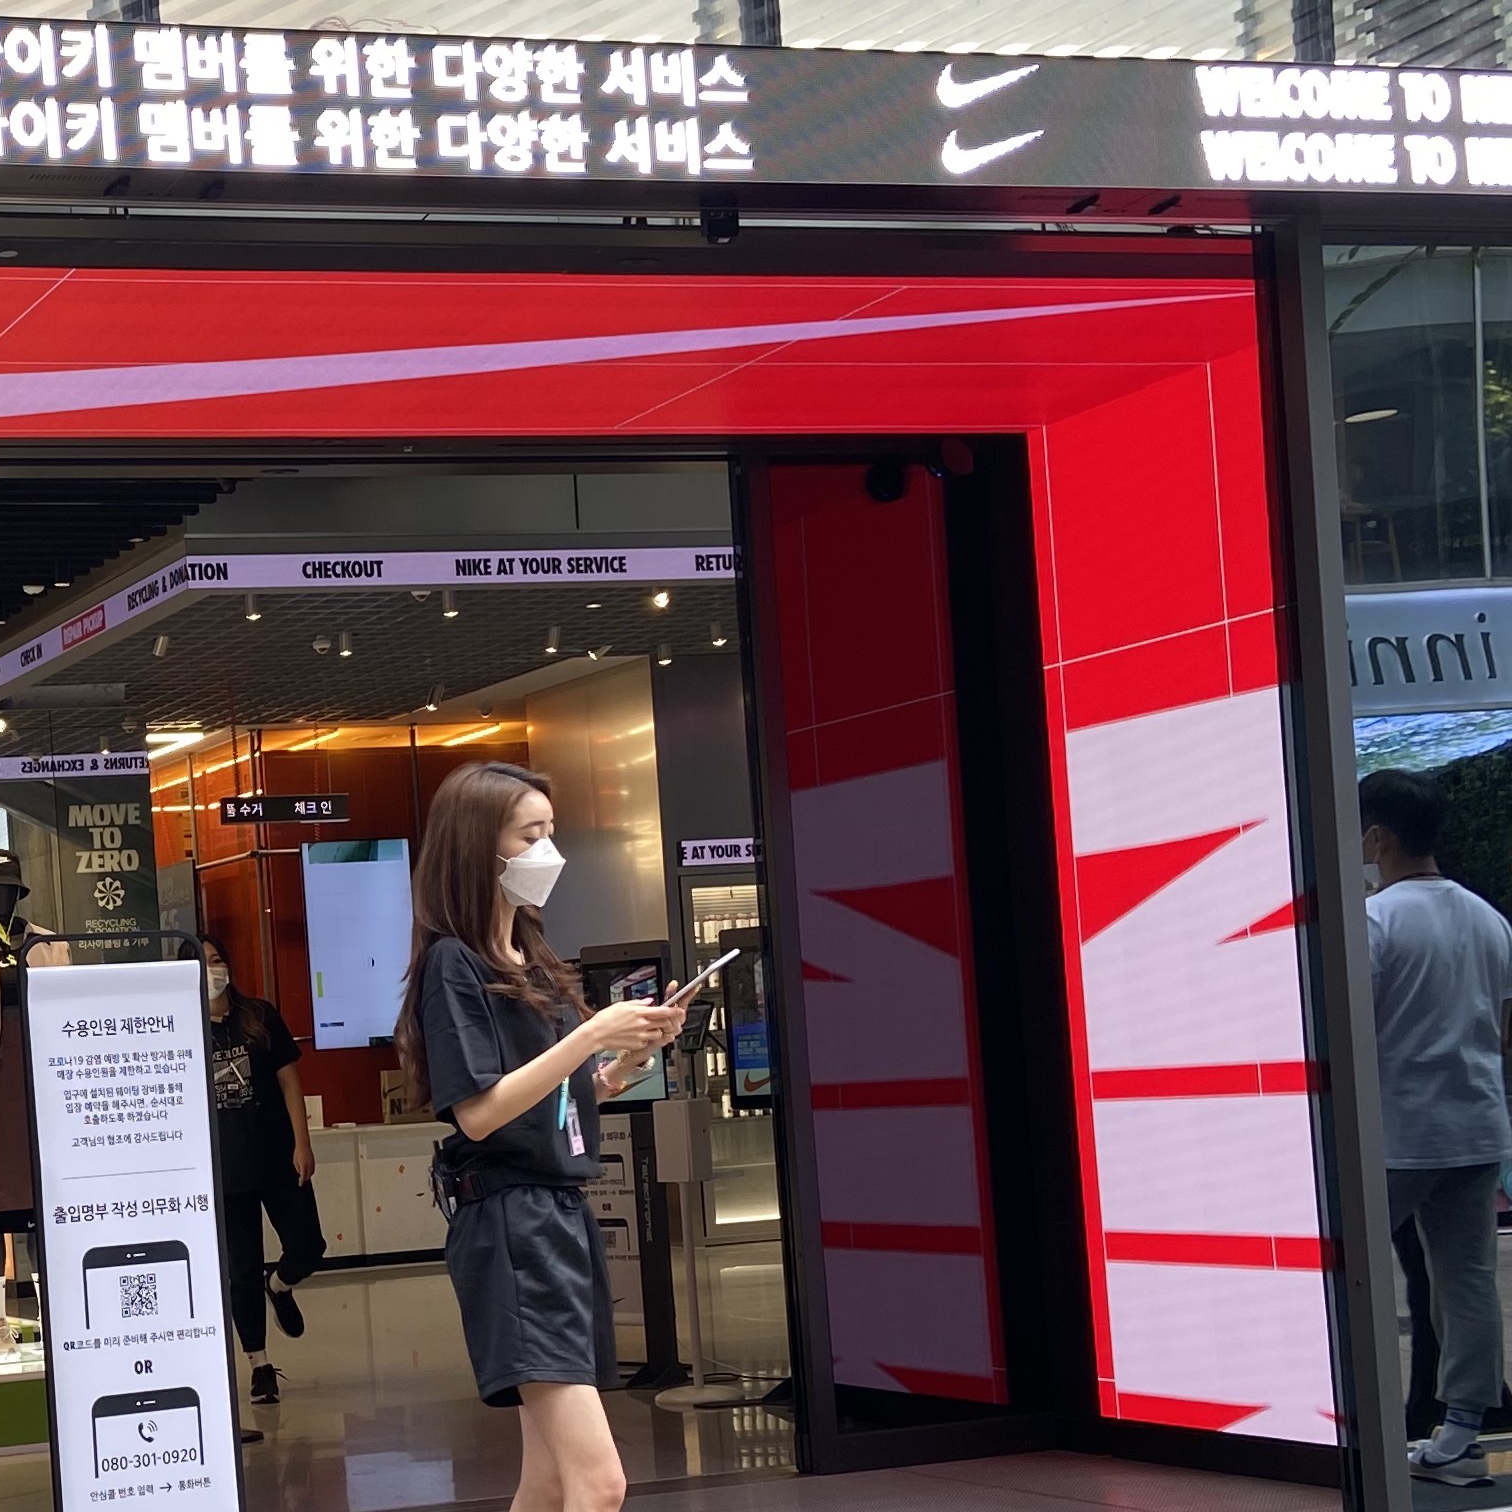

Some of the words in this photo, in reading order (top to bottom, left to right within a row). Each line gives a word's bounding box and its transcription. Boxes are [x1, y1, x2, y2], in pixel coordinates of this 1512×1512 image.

[134, 28, 295, 94] 멤버를
[310, 38, 415, 98] 위한
[433, 42, 584, 103] 다양한
[601, 49, 747, 106] 서비스
[1196, 66, 1392, 120] WELCOME
[1399, 73, 1451, 122] TO
[139, 101, 299, 165] 멤버를
[315, 109, 420, 168] 위한
[438, 111, 589, 172] 다양한
[606, 117, 752, 174] 서비스
[1201, 131, 1397, 182] WELCOME
[1404, 135, 1456, 184] TO
[169, 562, 228, 589] DONATION
[302, 560, 383, 579] CHECKOUT
[455, 558, 492, 576] NIKE
[497, 557, 515, 576] AT
[519, 557, 562, 575] YOUR
[567, 556, 627, 574] SERVICE
[68, 803, 141, 827] MOVE
[240, 802, 263, 817] 수거
[89, 827, 122, 849] TO
[75, 850, 140, 873] ZERO
[691, 846, 705, 860] AT
[708, 844, 742, 859] YOUR
[86, 918, 137, 928] RECYCLING
[62, 1018, 117, 1038] 수용인원
[120, 1015, 175, 1035] 제한안내
[48, 1055, 84, 1066] 코로나19
[53, 1203, 109, 1224] 출입명부
[111, 1200, 138, 1219] 작성
[141, 1197, 182, 1216] 의무화
[184, 1194, 209, 1212] 시행
[134, 1359, 153, 1375] OR
[101, 1447, 197, 1473] 080-301-0920
